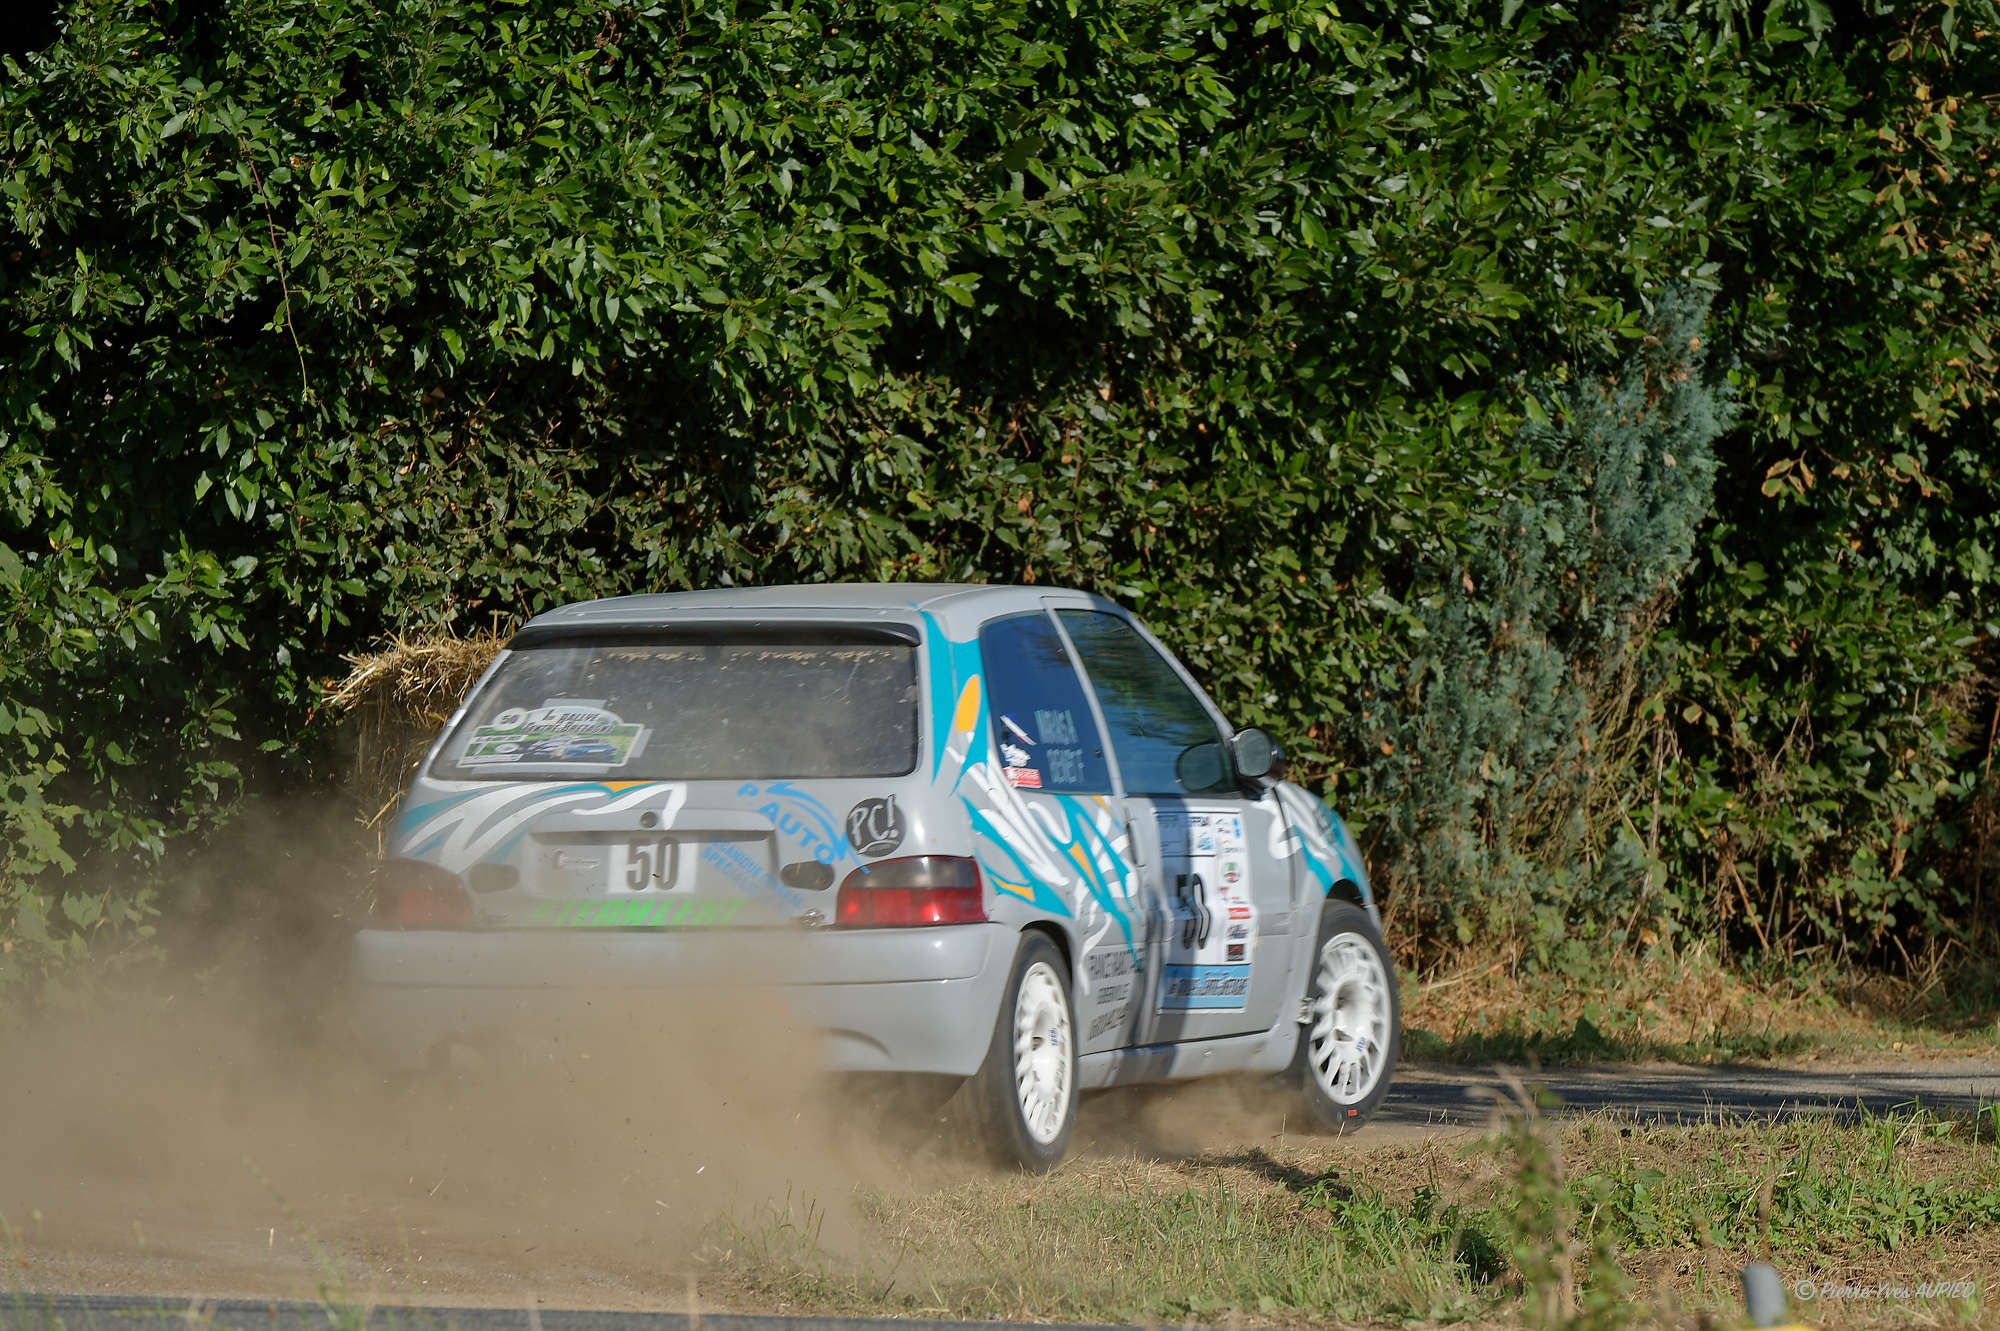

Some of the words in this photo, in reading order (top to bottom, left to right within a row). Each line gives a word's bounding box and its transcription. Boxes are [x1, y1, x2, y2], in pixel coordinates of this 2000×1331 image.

[500, 713, 520, 725] 50
[757, 801, 834, 865] AUTO
[626, 836, 679, 891] 50
